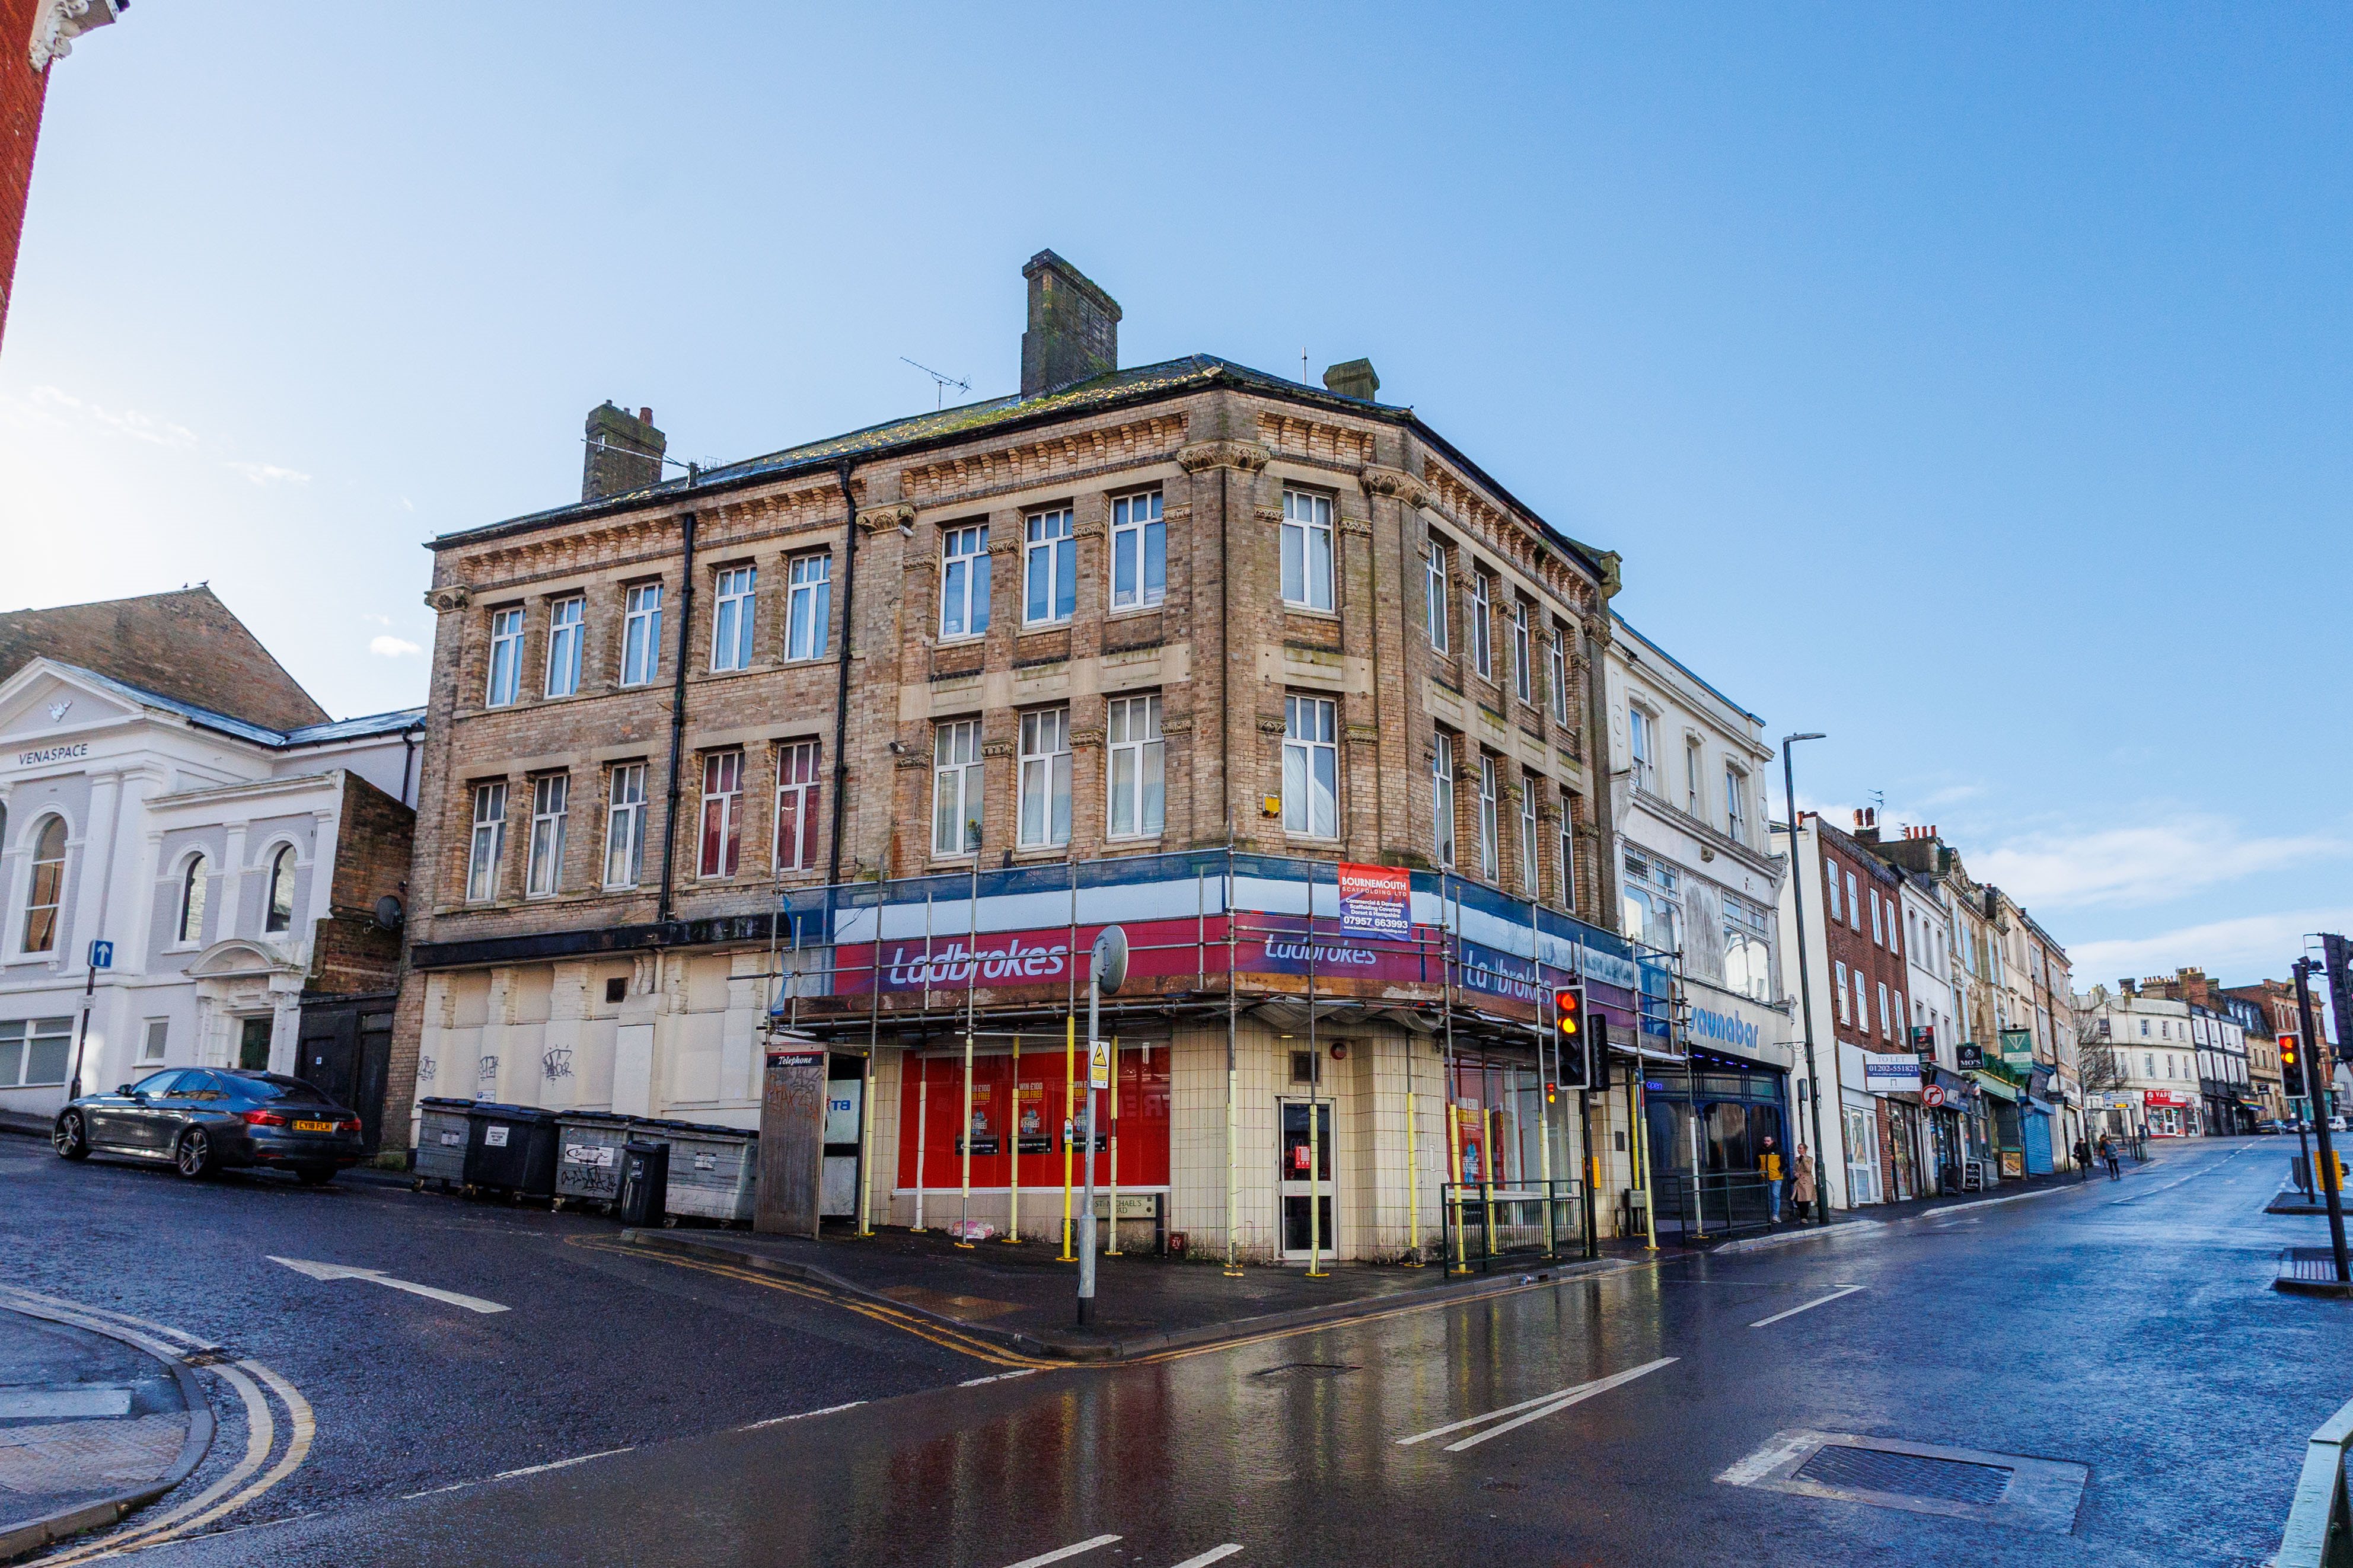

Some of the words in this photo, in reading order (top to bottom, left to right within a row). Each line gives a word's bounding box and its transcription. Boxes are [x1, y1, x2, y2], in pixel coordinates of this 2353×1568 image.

[19, 743, 88, 765] VENASPACE
[1342, 877, 1407, 891] BOURNEMOUTH
[1342, 886, 1391, 896] SCAFFOLDING
[1343, 916, 1372, 925] 07957
[1374, 918, 1408, 929] 663993
[1265, 934, 1376, 965] Ladbrokes
[889, 939, 1067, 984] Ladbrokes
[1466, 950, 1552, 1004] Ladbrokes
[1690, 1007, 1758, 1049] saunabar
[778, 1055, 812, 1066] Telephone
[1030, 1082, 1043, 1090] £100
[978, 1092, 990, 1100] FREE
[1019, 1091, 1029, 1099] FOR
[1030, 1090, 1043, 1098] FREE
